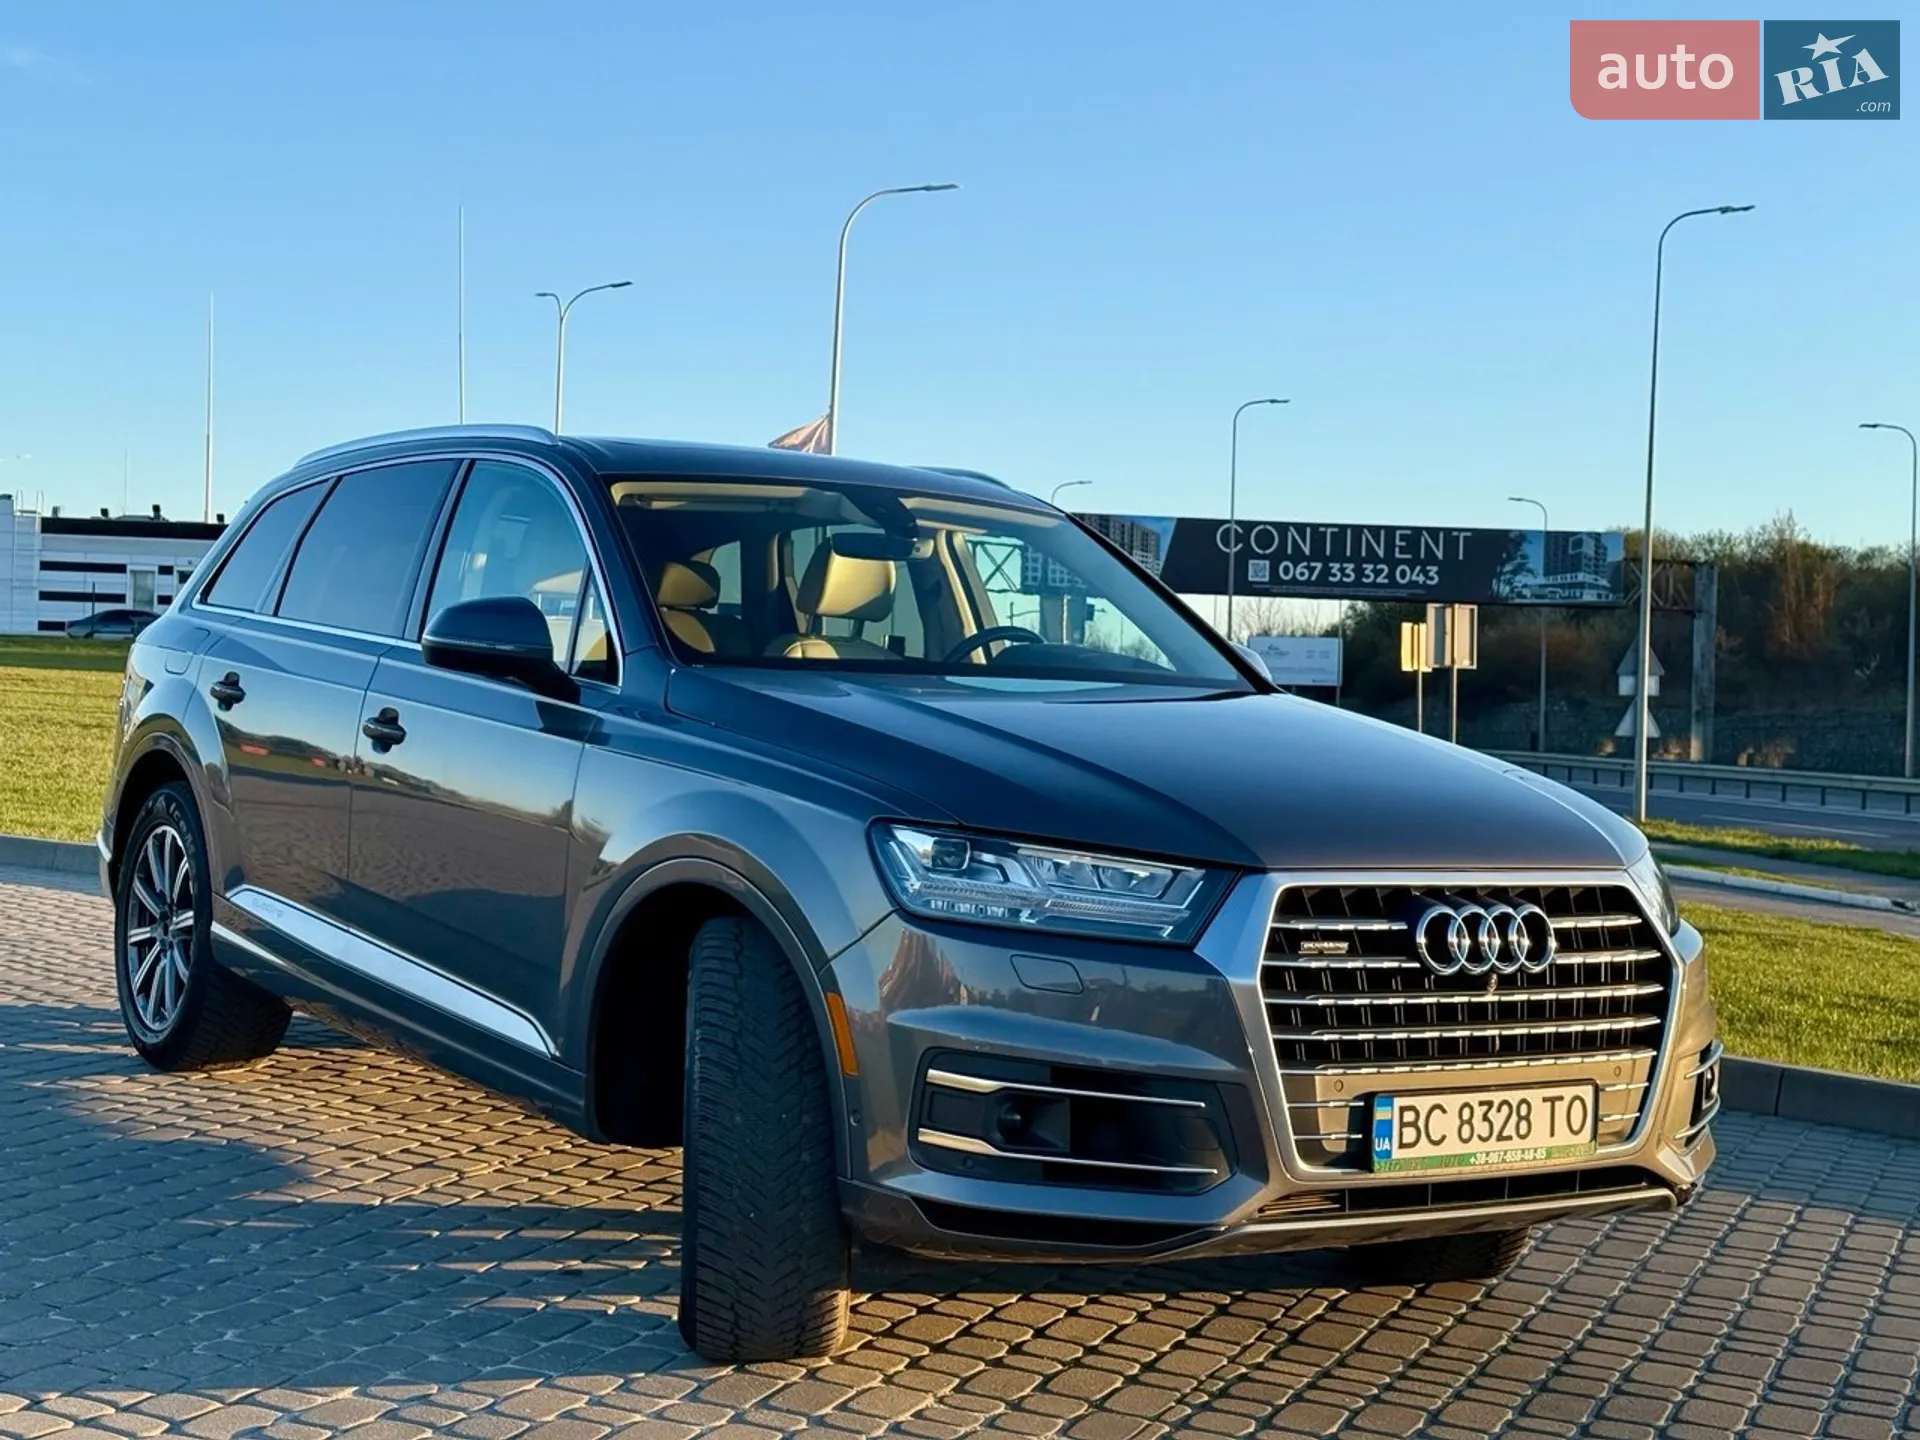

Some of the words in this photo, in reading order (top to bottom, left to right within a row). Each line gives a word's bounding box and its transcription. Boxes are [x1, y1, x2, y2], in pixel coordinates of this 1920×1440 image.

[1216, 523, 1472, 561] CONTINENT
[1279, 560, 1323, 582] 067
[1328, 562, 1356, 583] 33
[1361, 563, 1389, 584] 32
[1395, 564, 1440, 586] 043
[1397, 1103, 1448, 1150] BC
[1457, 1097, 1533, 1145] 8328
[1542, 1094, 1588, 1138] TO
[1375, 1138, 1391, 1152] UA
